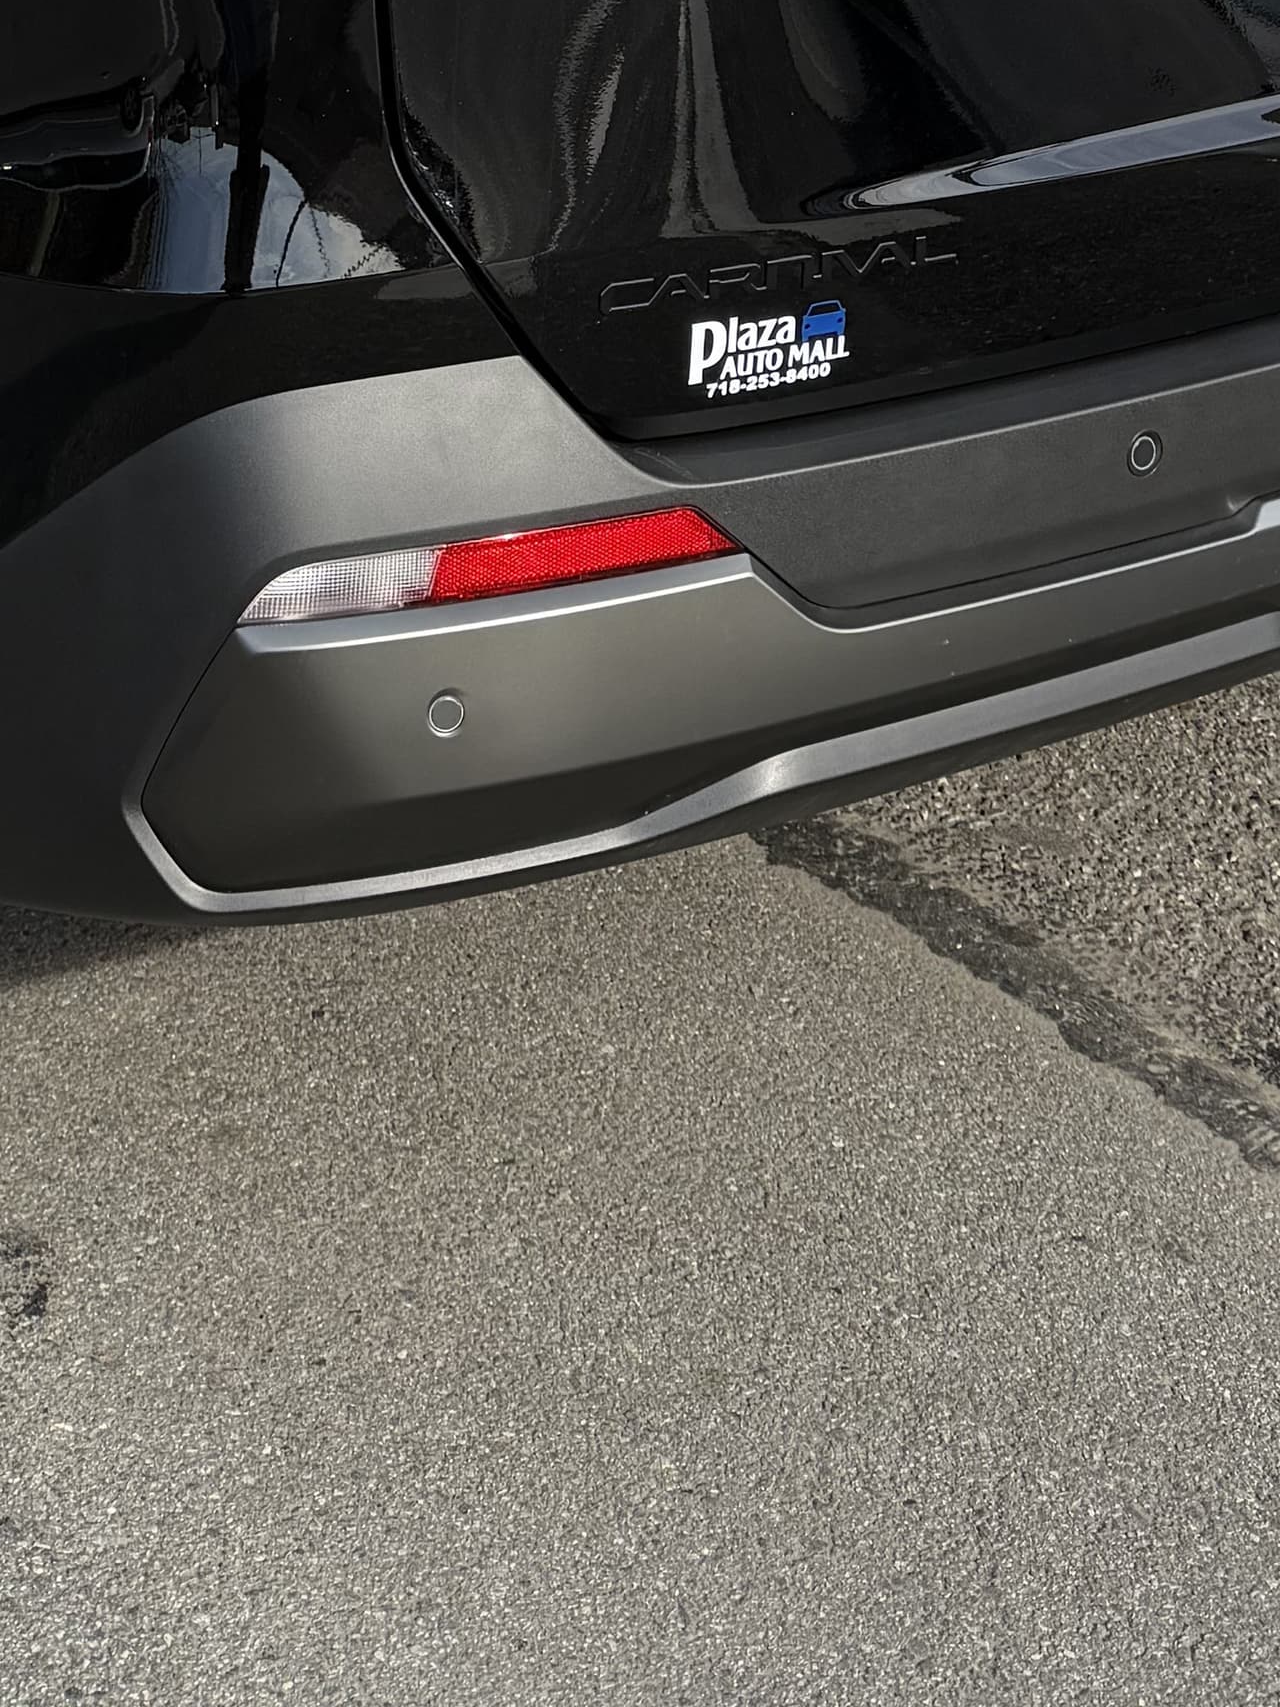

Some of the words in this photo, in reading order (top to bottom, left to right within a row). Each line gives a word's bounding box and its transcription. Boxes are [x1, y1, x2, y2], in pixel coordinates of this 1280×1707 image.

[599, 236, 959, 314] CARNIVAL
[687, 316, 797, 386] Plaza
[720, 348, 784, 380] AUTO
[787, 335, 850, 367] MALL
[706, 362, 831, 398] 718-253-8400
